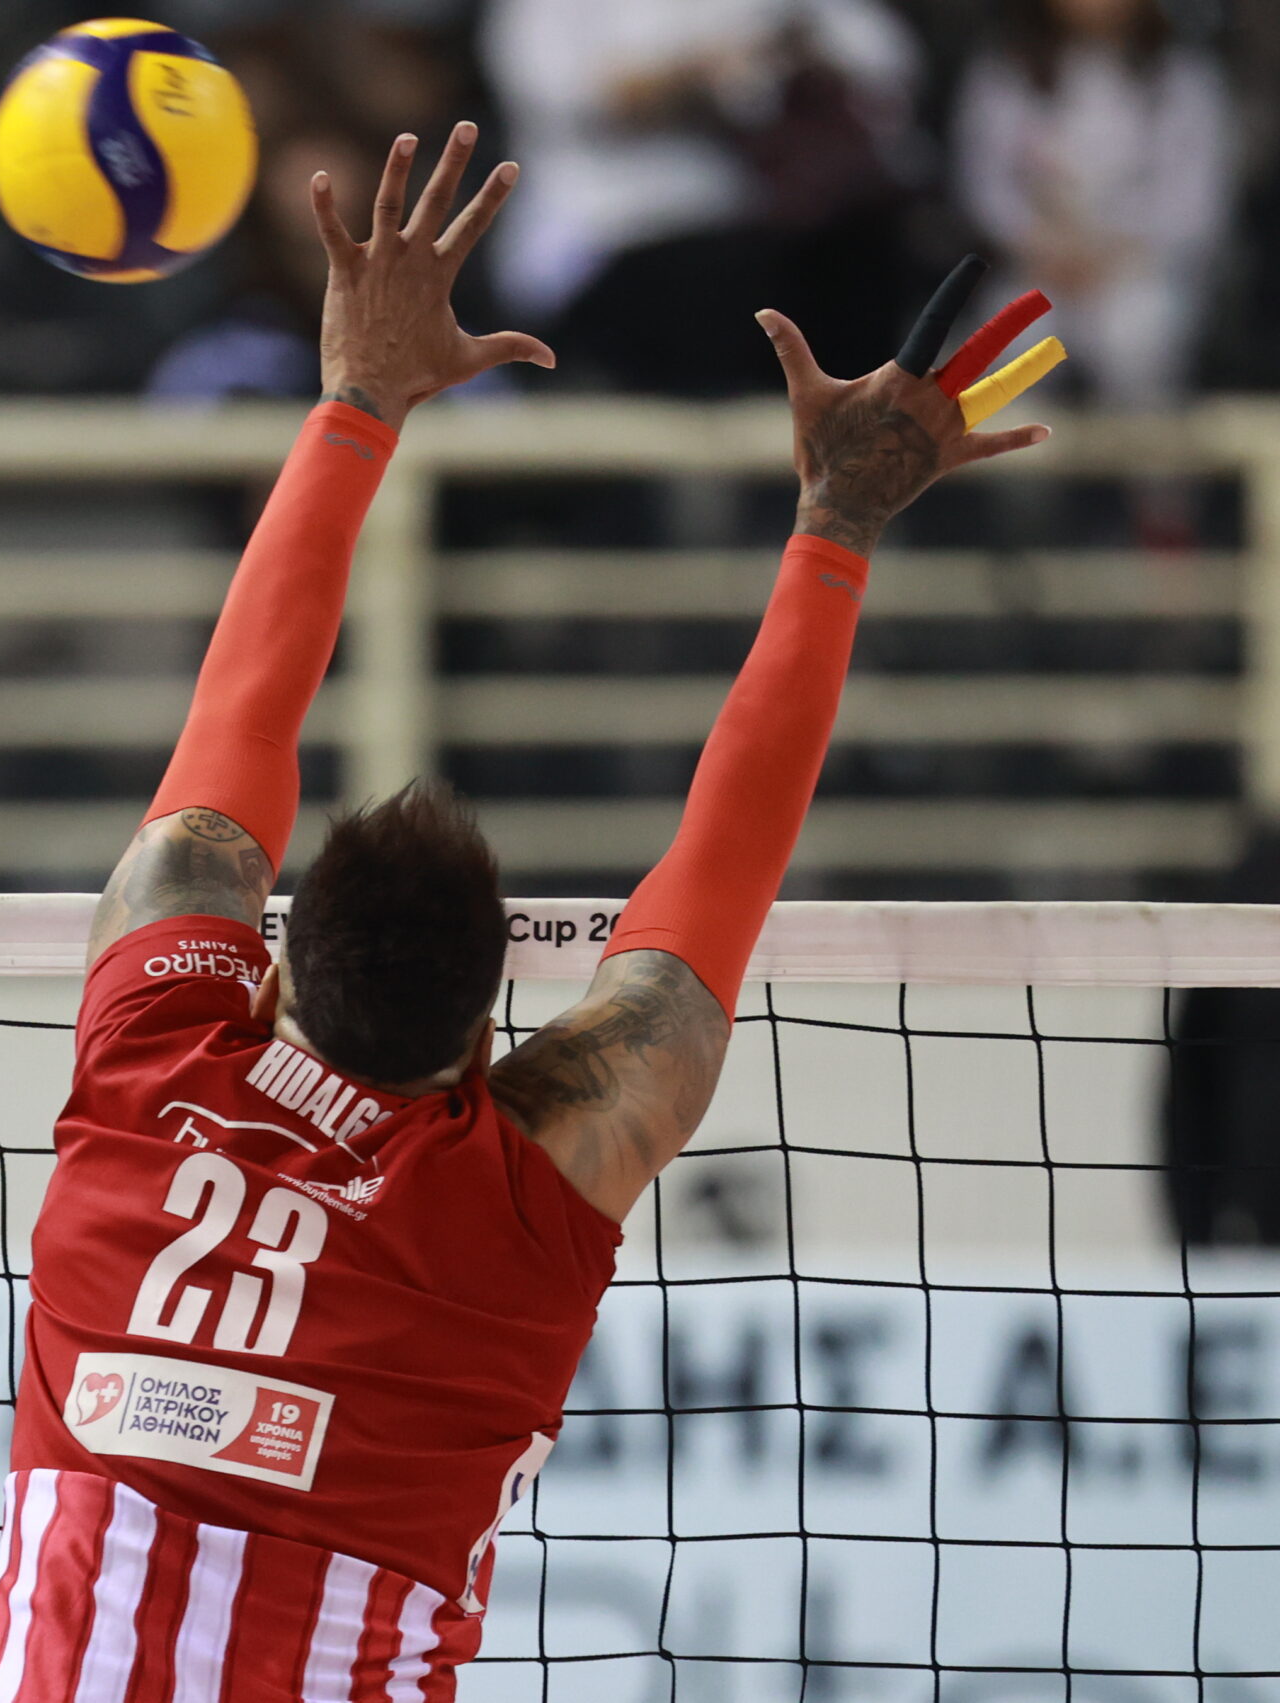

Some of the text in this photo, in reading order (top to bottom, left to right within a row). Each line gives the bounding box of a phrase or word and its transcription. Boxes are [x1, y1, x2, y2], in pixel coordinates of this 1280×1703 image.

[506, 913, 577, 948] Cup
[177, 940, 238, 953] PAINTS
[144, 952, 261, 982] VECHRO
[245, 1039, 395, 1143] HIDALG
[126, 1152, 329, 1357] 23
[140, 1377, 222, 1405] ΟΜΙΛΟΣ
[135, 1396, 229, 1425] ΙΑΤΡΙΚΟΥ
[271, 1402, 301, 1425] 19
[129, 1414, 221, 1444] ΑΘΗΝΩΝ
[255, 1422, 304, 1442] ΧΡΟΝΙΑ
